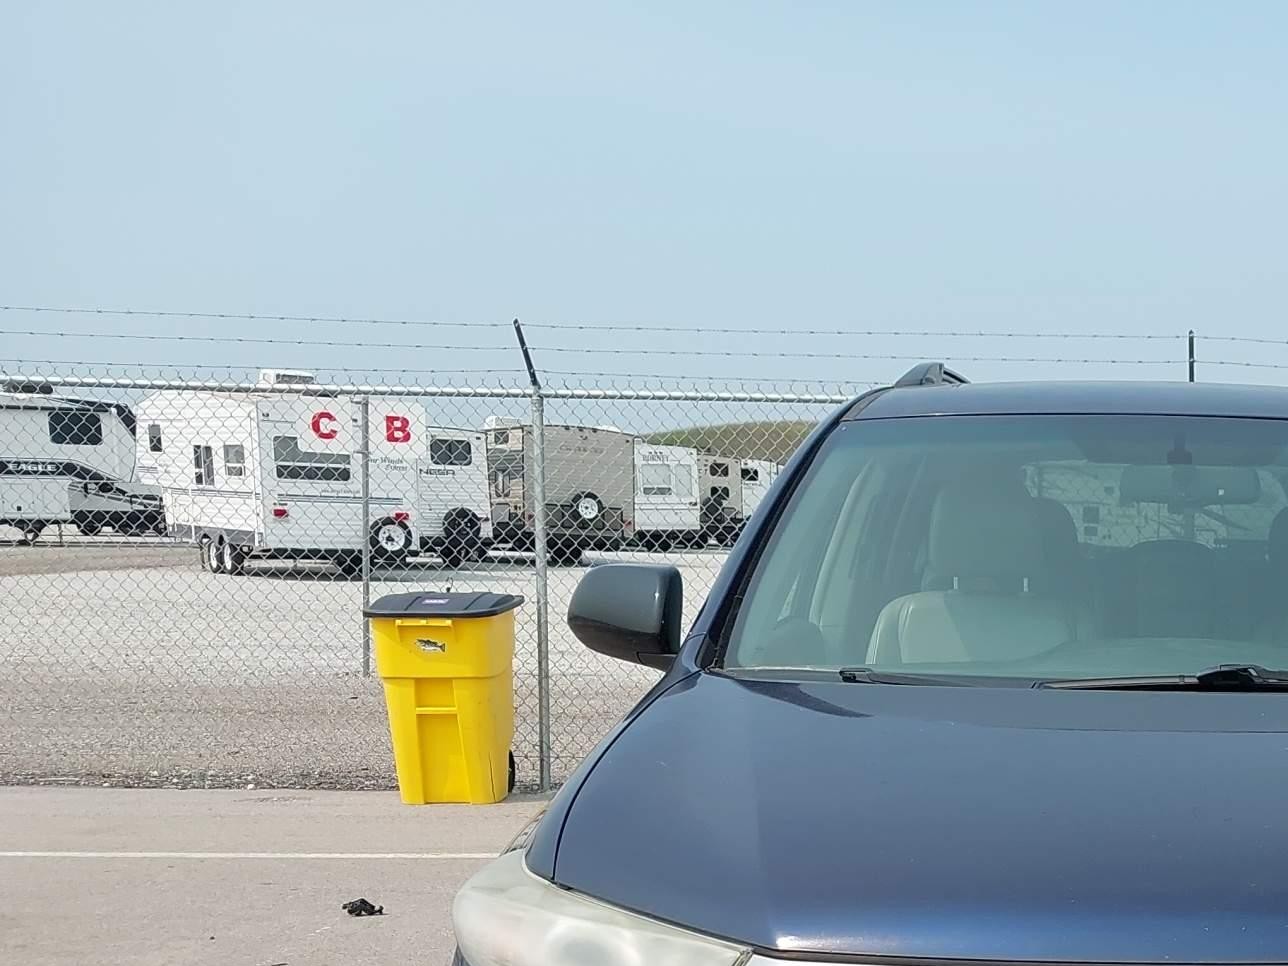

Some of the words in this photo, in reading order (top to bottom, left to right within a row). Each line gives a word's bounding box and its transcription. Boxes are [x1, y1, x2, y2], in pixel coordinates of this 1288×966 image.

[311, 411, 337, 440] C
[385, 415, 411, 443] B
[8, 463, 58, 472] EAGLE
